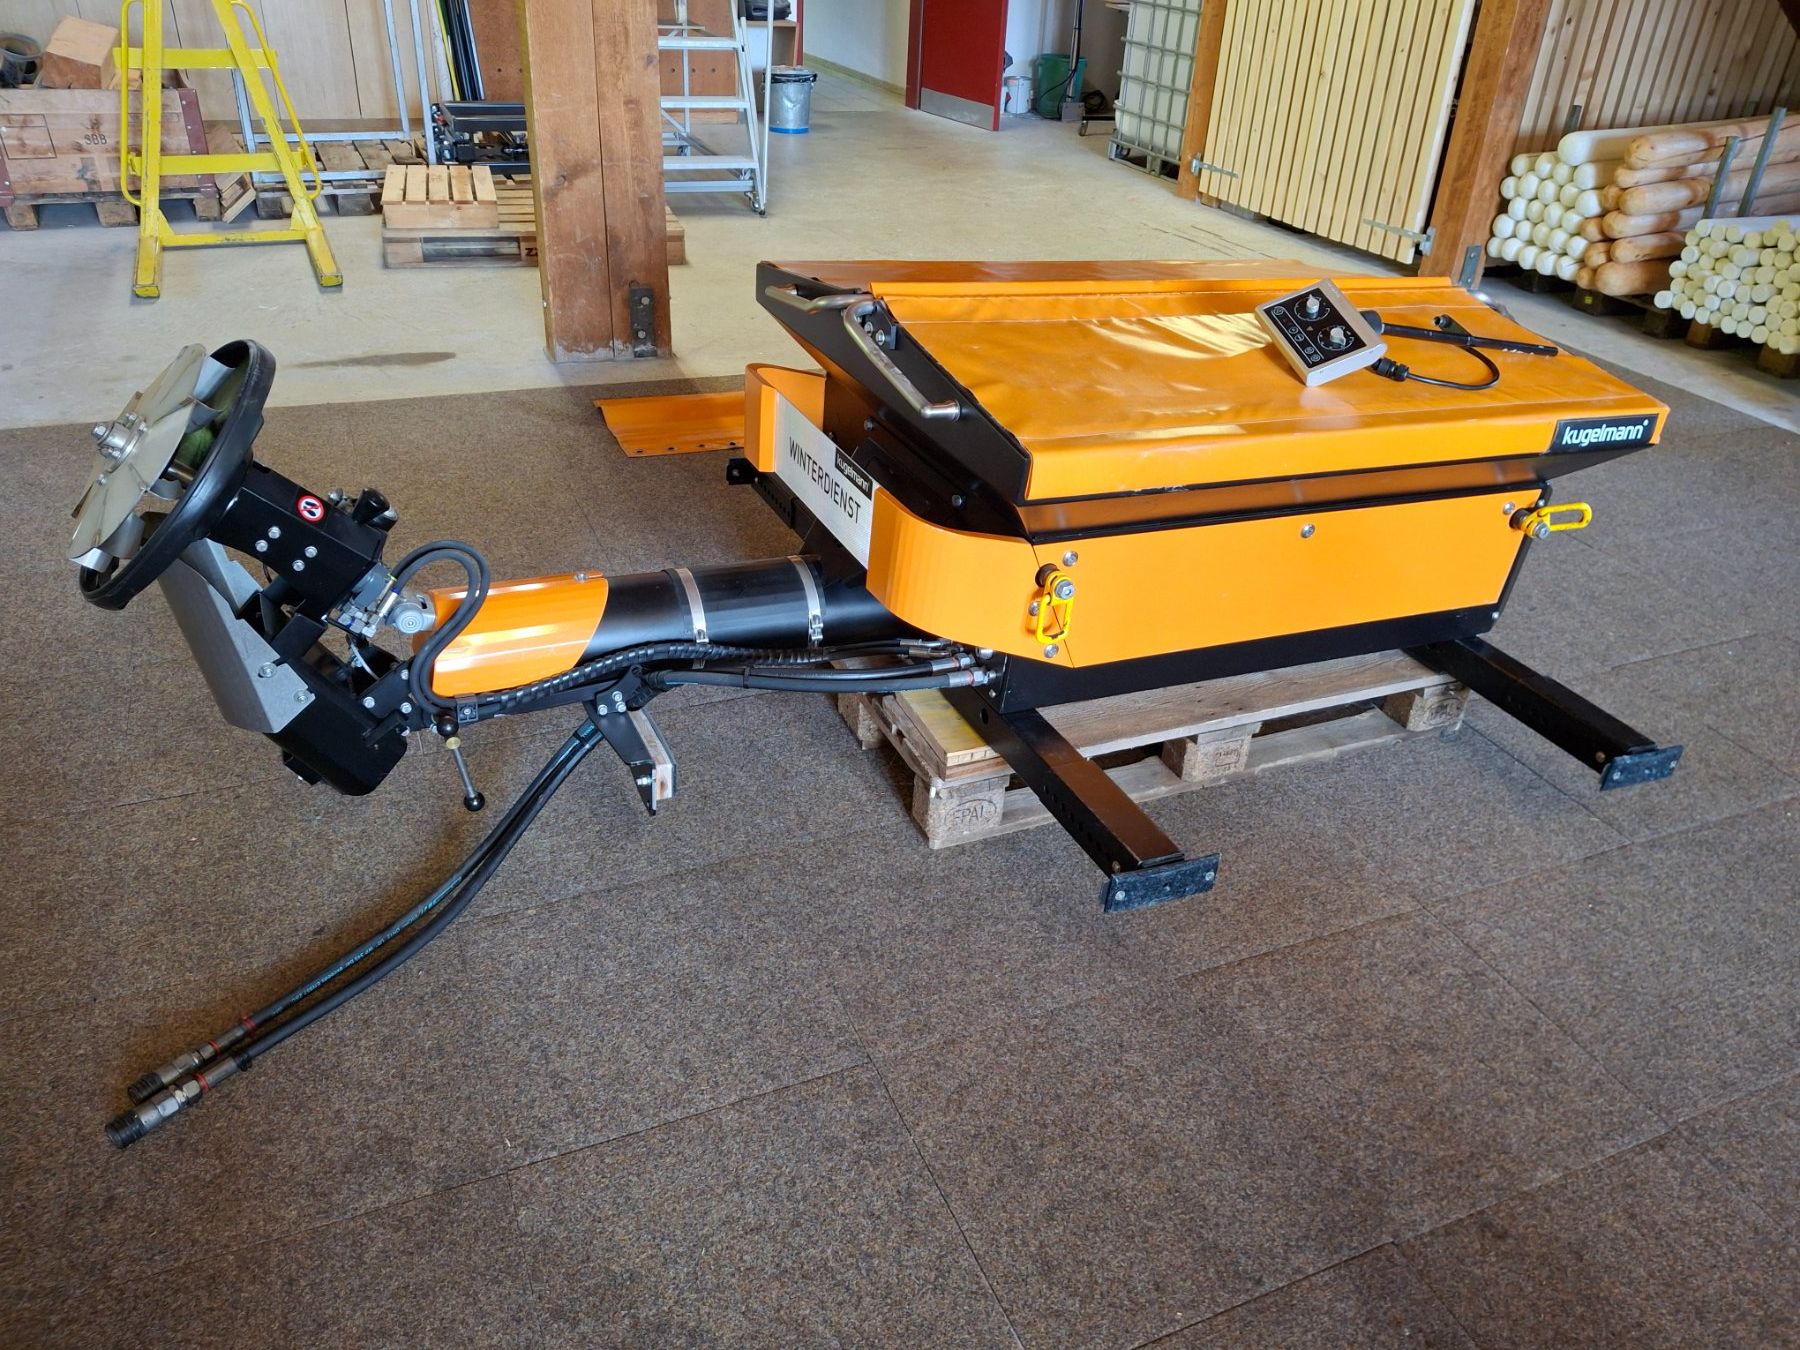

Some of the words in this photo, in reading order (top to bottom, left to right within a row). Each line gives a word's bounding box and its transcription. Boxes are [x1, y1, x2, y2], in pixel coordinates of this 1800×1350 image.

[84, 134, 107, 146] SBB
[1562, 420, 1646, 447] kugelmann
[788, 434, 861, 524] WINTERDIENST
[835, 450, 870, 493] kugelmann
